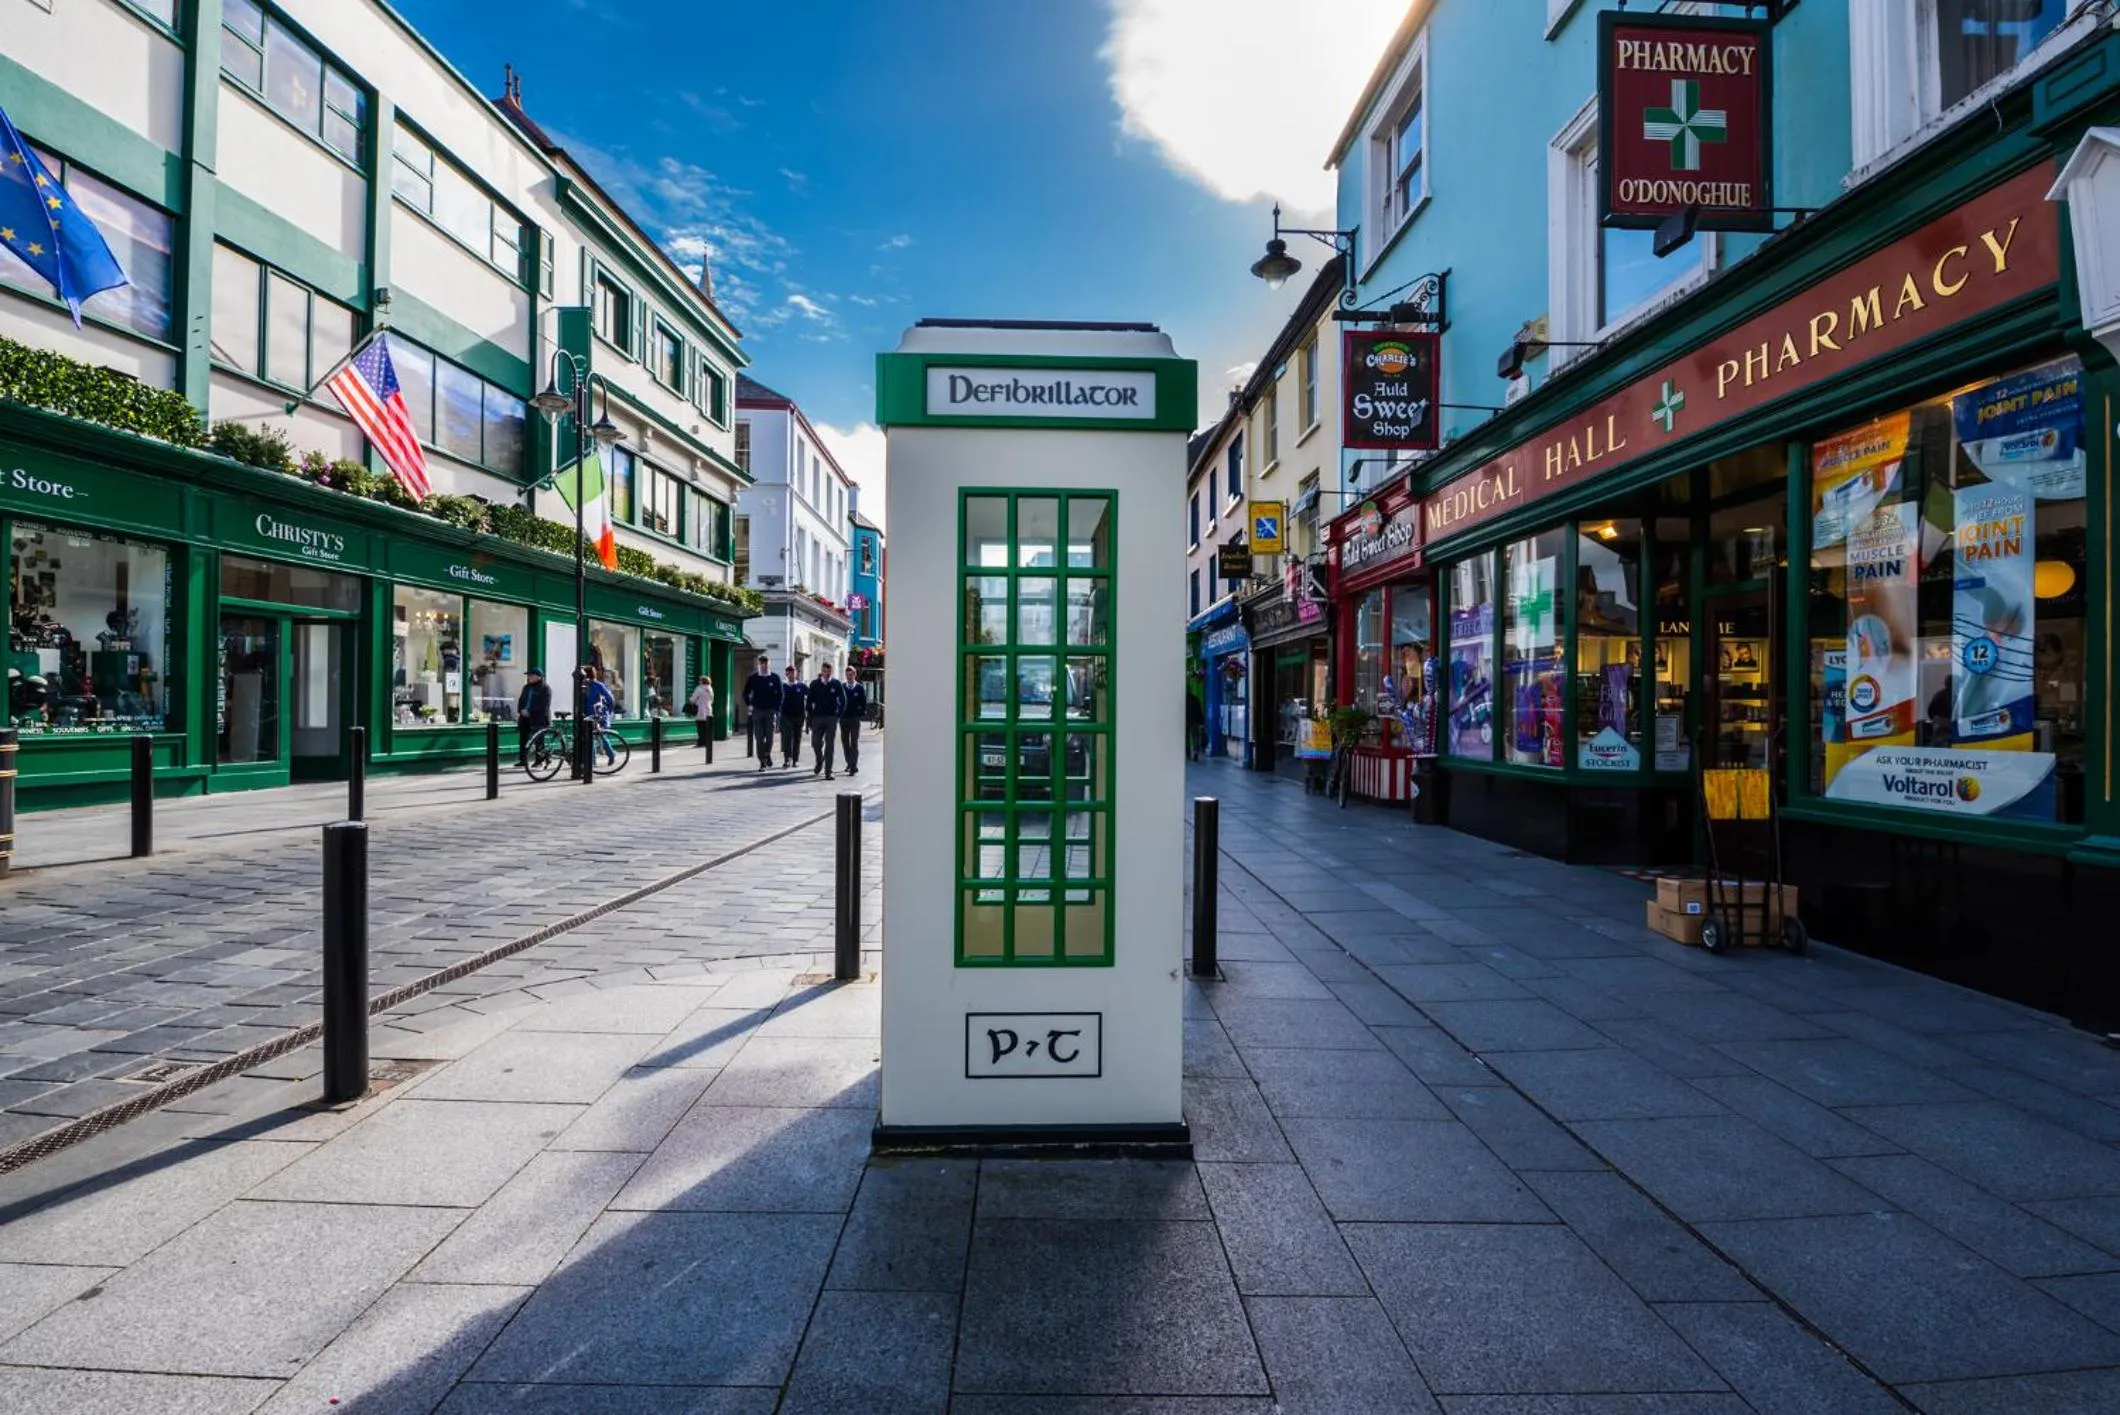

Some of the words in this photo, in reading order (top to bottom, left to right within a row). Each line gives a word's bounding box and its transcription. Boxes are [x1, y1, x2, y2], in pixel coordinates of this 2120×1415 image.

[1617, 40, 1755, 75] PHARMACY
[1619, 179, 1751, 206] O'DONOGHUE
[1427, 466, 1521, 531] MEDICAL
[1545, 414, 1626, 480] HALL
[1717, 217, 2020, 400] PHARMACY
[1374, 382, 1408, 397] Auld
[1353, 394, 1429, 419] Sweet
[1977, 394, 2027, 425] JOINT
[2031, 380, 2077, 406] PAIN
[1373, 421, 1410, 439] Shop
[12, 468, 74, 498] Store
[256, 514, 344, 552] CHRISTY'S
[1957, 515, 2025, 549] JOINT
[302, 546, 318, 556] Gift
[319, 549, 340, 560] Store
[1850, 544, 1904, 561] MUSCLE
[1965, 536, 2022, 561] PAIN
[449, 564, 469, 580] Gift
[471, 568, 495, 585] Store
[1855, 559, 1901, 579] PAIN
[1972, 645, 1989, 659] 12
[1585, 759, 1630, 767] STOCKIST
[1876, 756, 1893, 765] ASK
[1895, 756, 1921, 766] YOUR
[1922, 758, 1988, 770] PHARMACIST
[1882, 774, 1953, 797] Voltarol
